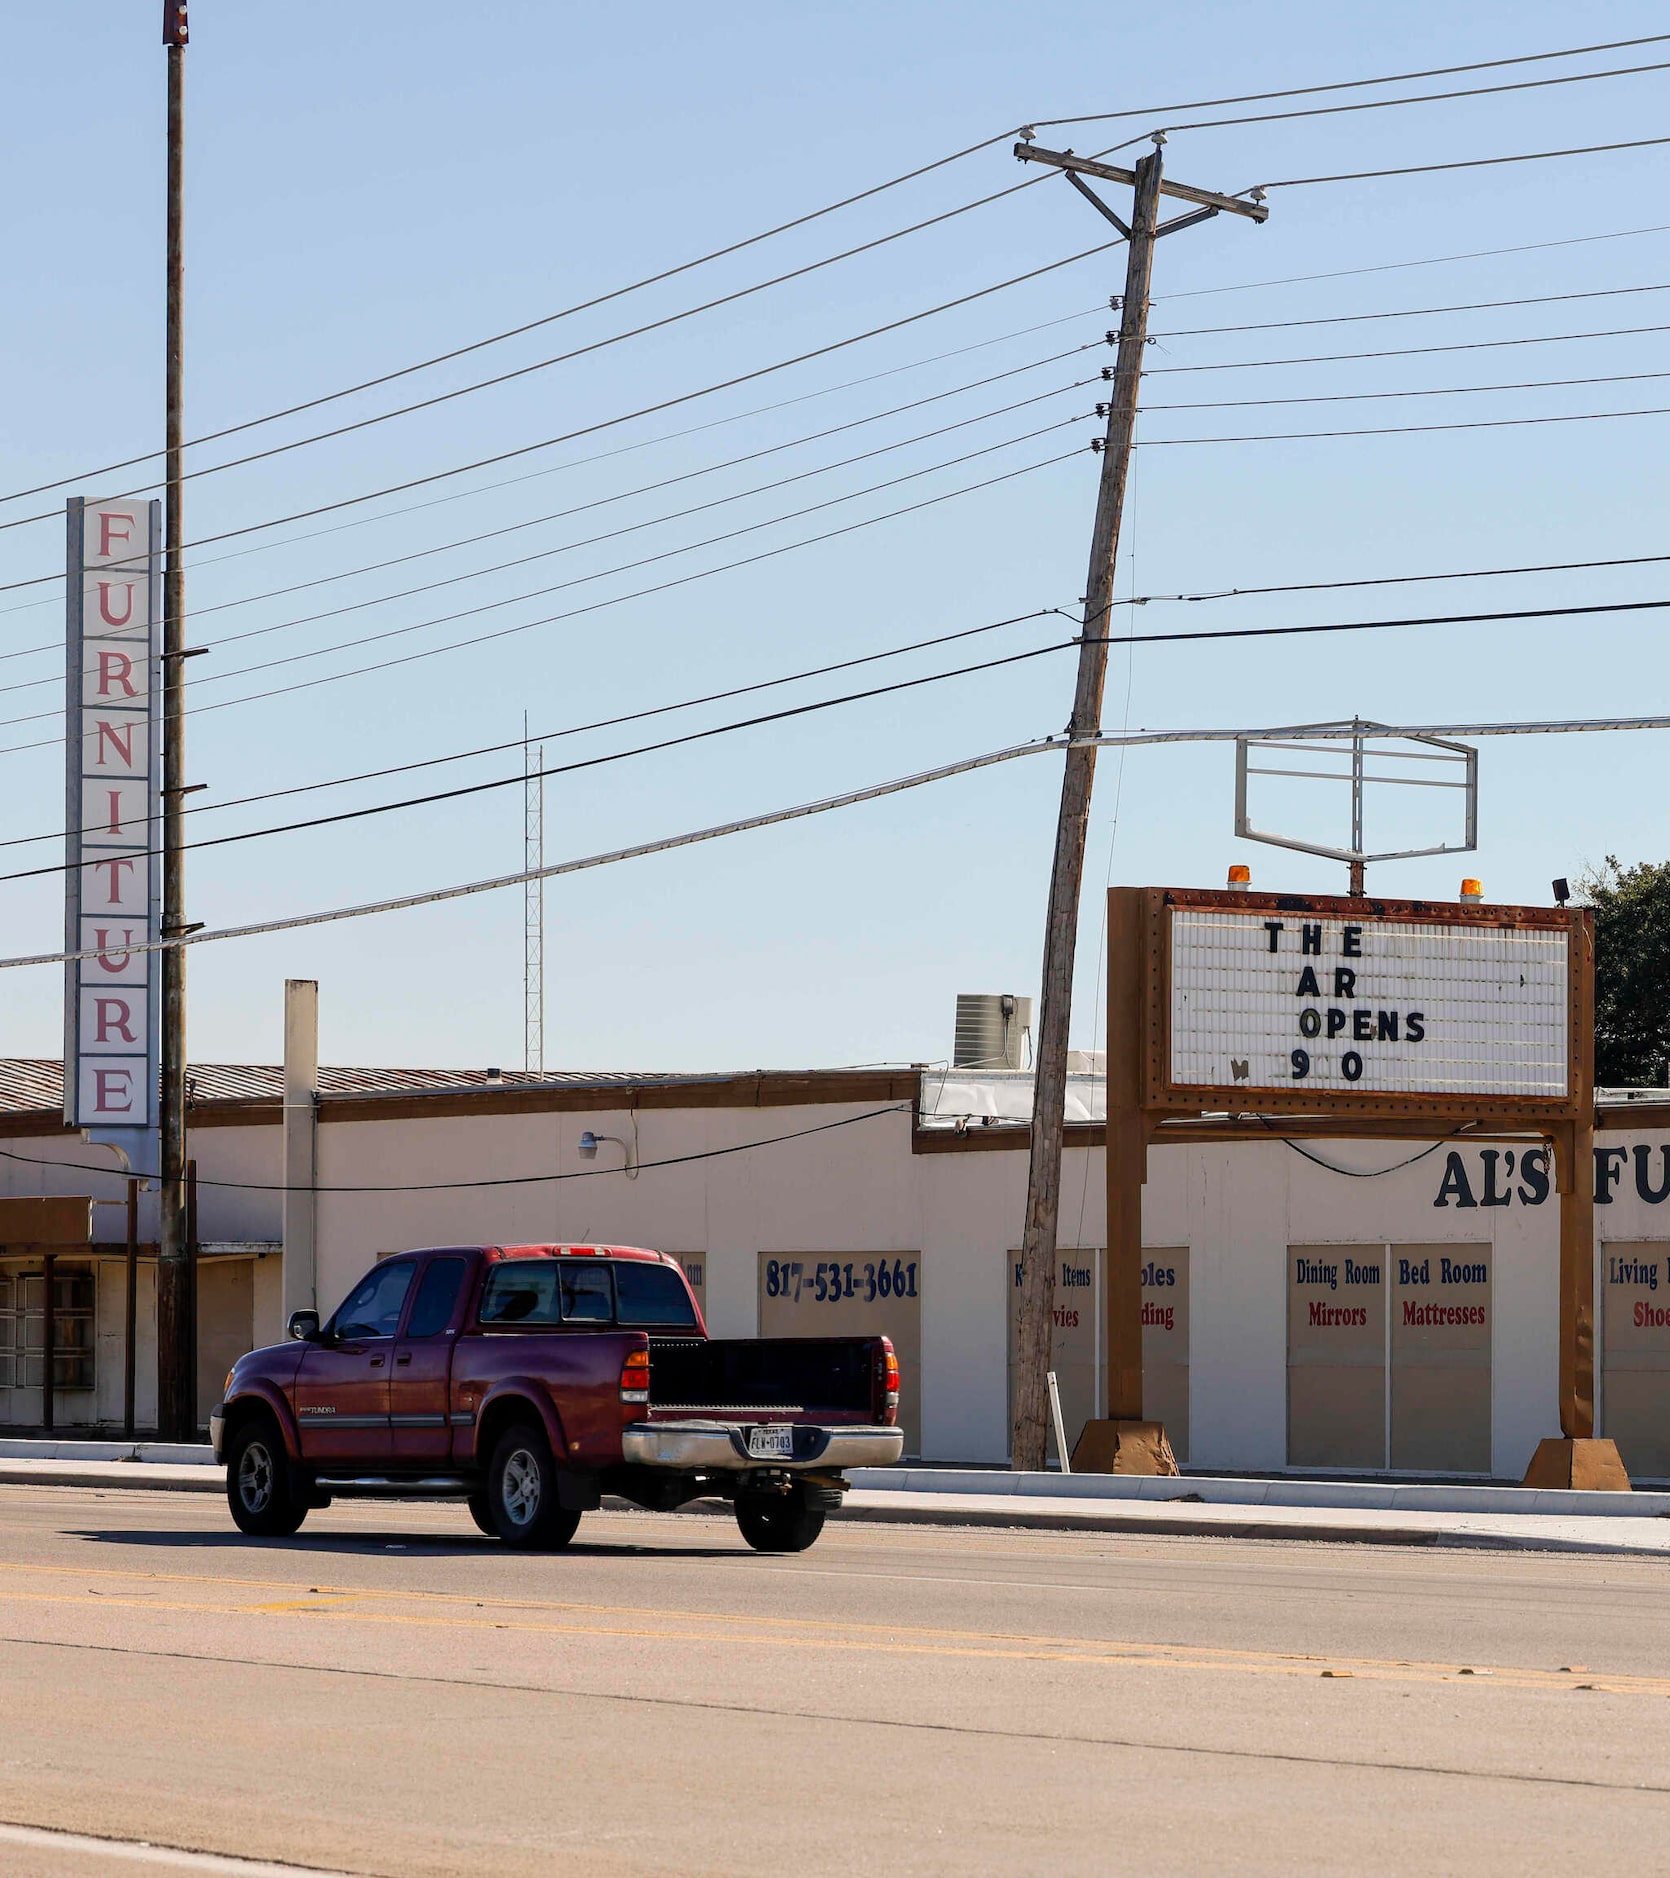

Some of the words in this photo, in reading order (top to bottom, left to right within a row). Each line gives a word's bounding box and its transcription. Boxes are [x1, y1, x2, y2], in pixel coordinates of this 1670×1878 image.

[92, 512, 139, 1112] FURNITURE
[1264, 922, 1362, 957] THE
[1297, 966, 1355, 999] AR
[1300, 1008, 1425, 1042] OPENS
[1434, 1149, 1550, 1207] AL'S
[767, 1259, 917, 1302] 817-531-3661
[1063, 1264, 1090, 1287] Items
[1297, 1258, 1338, 1290] Dining
[1345, 1259, 1380, 1285] Room
[1399, 1259, 1429, 1285] Bed
[1441, 1258, 1487, 1284] Room
[1609, 1258, 1658, 1290] Living
[1308, 1302, 1367, 1327] Mirrors
[1403, 1301, 1485, 1326] Mattresses
